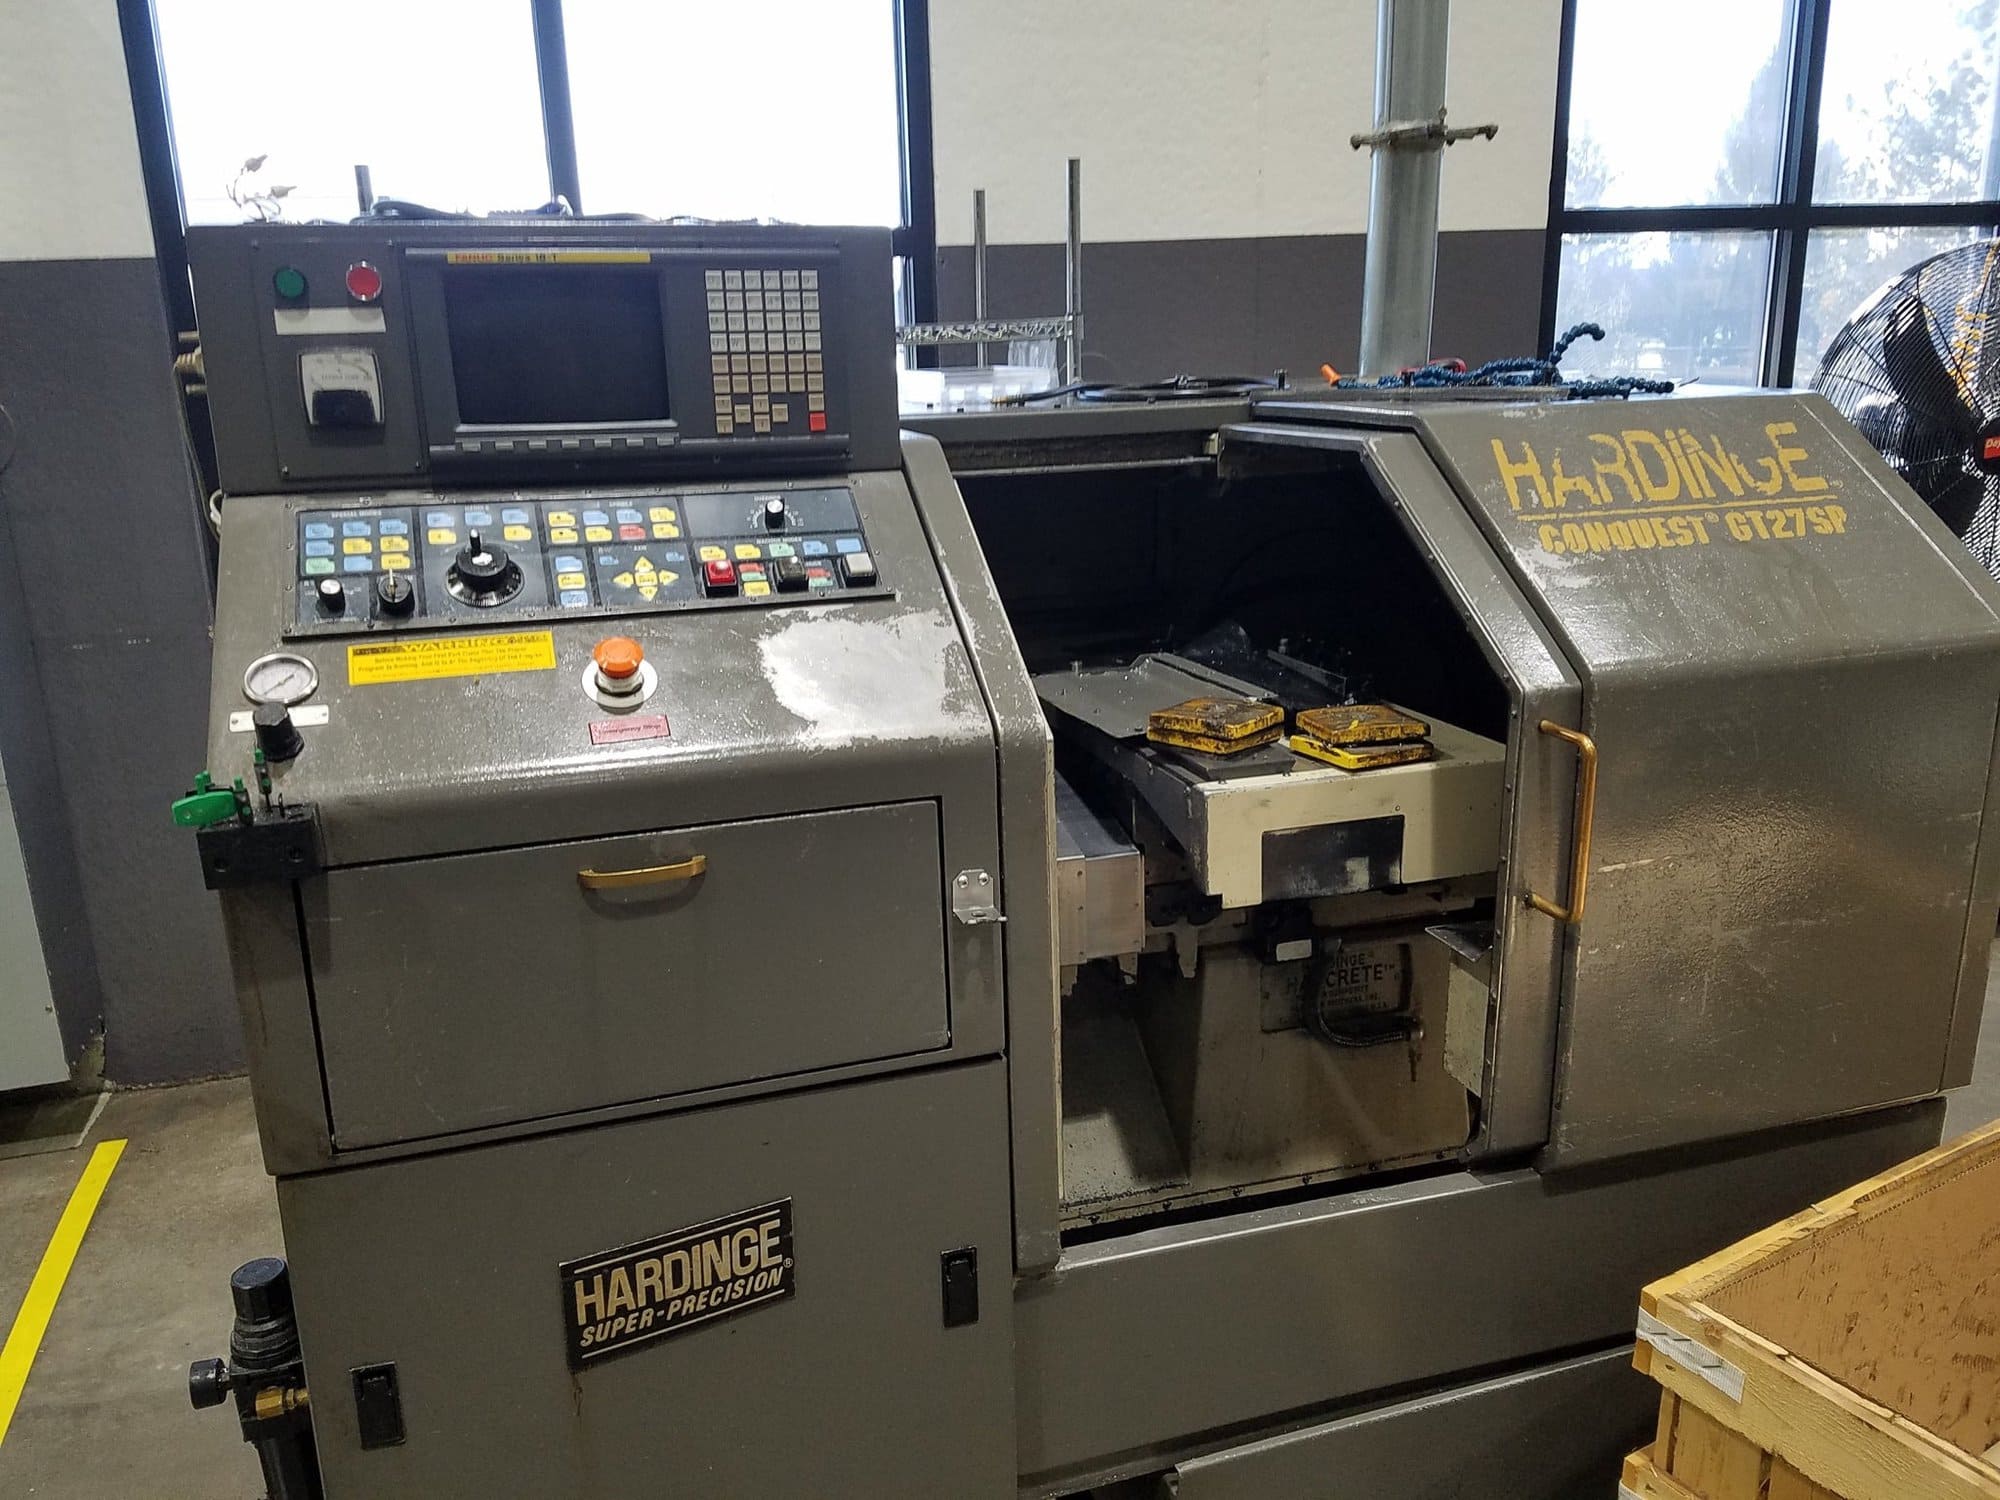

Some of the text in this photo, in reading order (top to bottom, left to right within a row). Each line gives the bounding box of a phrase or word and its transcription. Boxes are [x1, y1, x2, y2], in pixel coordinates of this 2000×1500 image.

[1490, 421, 1829, 511] HARDINGE
[1725, 505, 1848, 542] GT27SP
[574, 1218, 783, 1326] HARDINGE
[579, 1265, 784, 1348] SUPER-PRECISION
